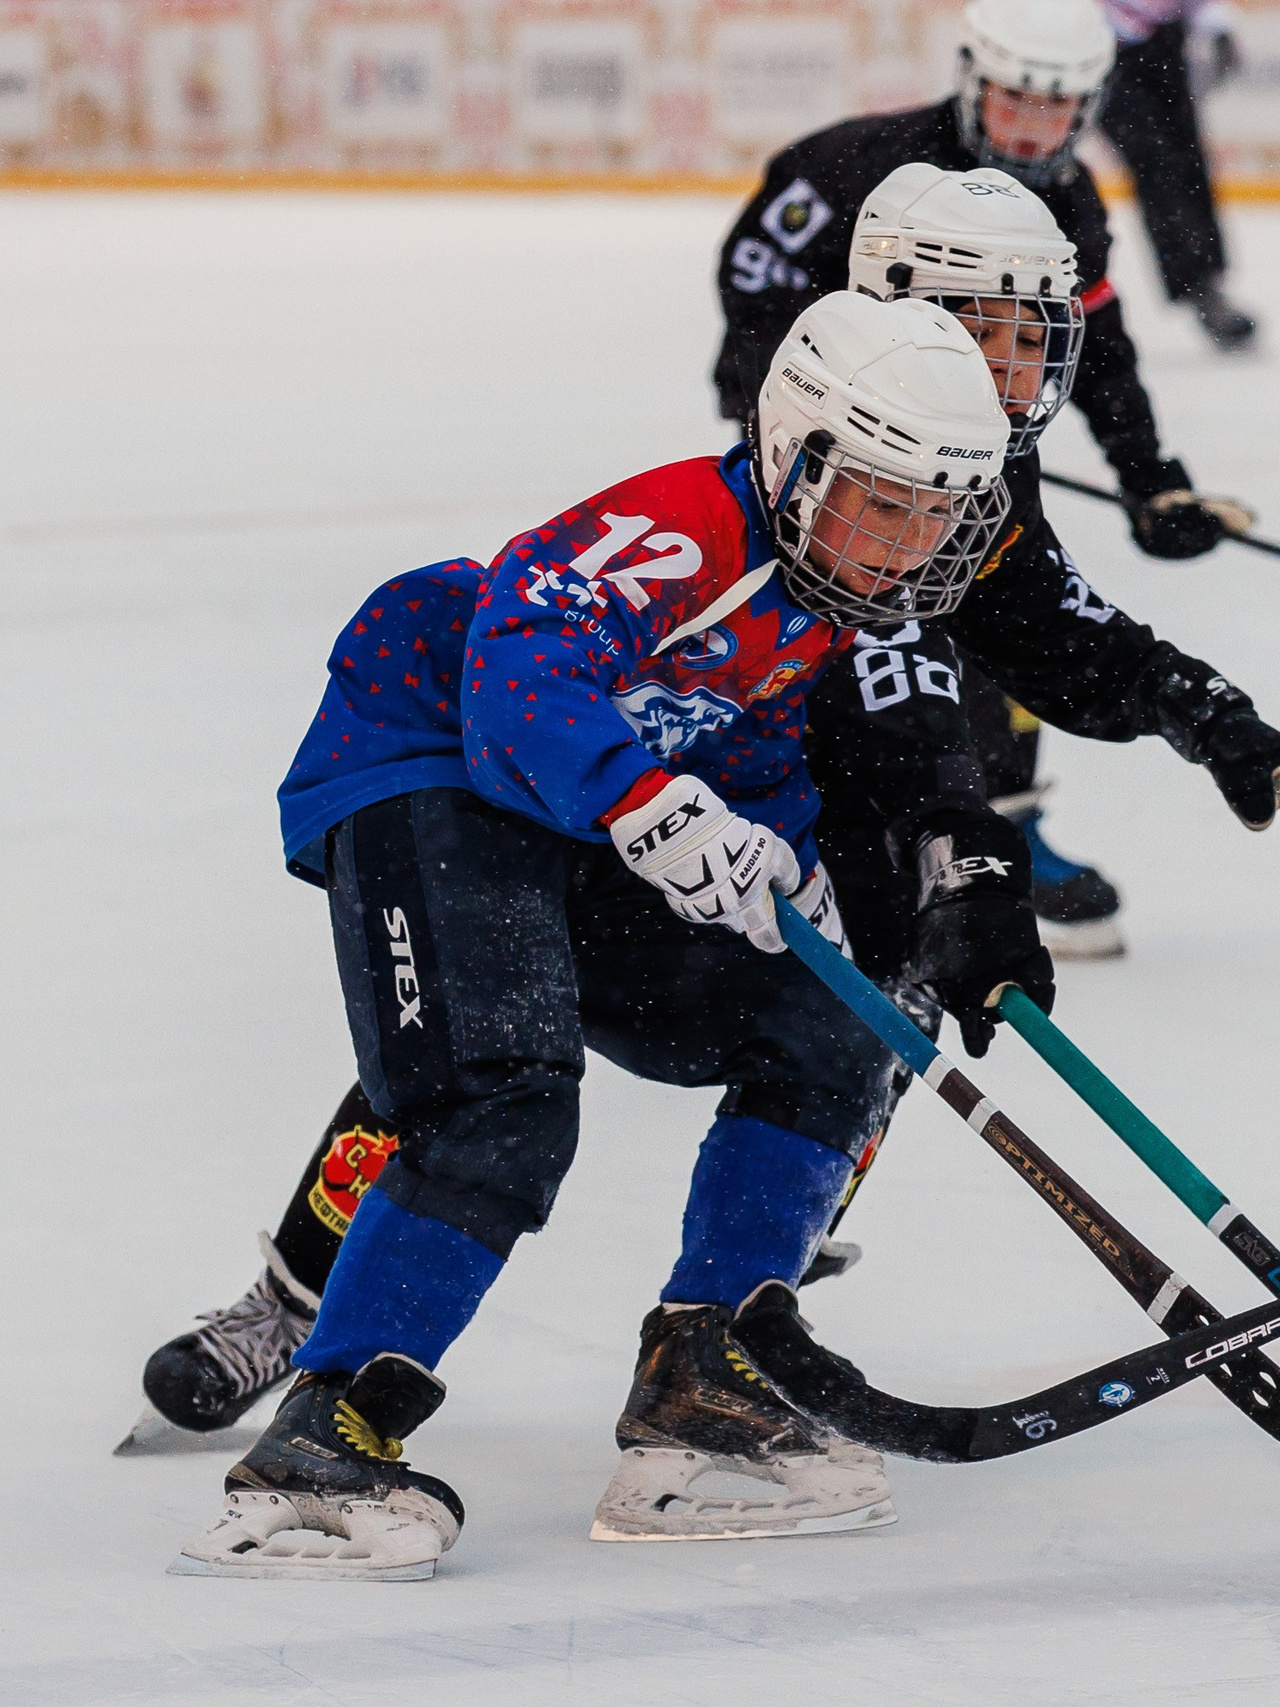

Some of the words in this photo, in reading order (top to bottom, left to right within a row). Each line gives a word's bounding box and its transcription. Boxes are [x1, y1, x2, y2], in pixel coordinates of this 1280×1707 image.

[781, 366, 825, 400] BAUER
[936, 445, 994, 460] BAUER
[568, 511, 702, 611] 12
[626, 793, 707, 863] STEX
[739, 847, 762, 880] RAIDER
[757, 837, 767, 850] 90
[383, 906, 424, 1029] STEX
[987, 1122, 1121, 1258] OPTIMIZED
